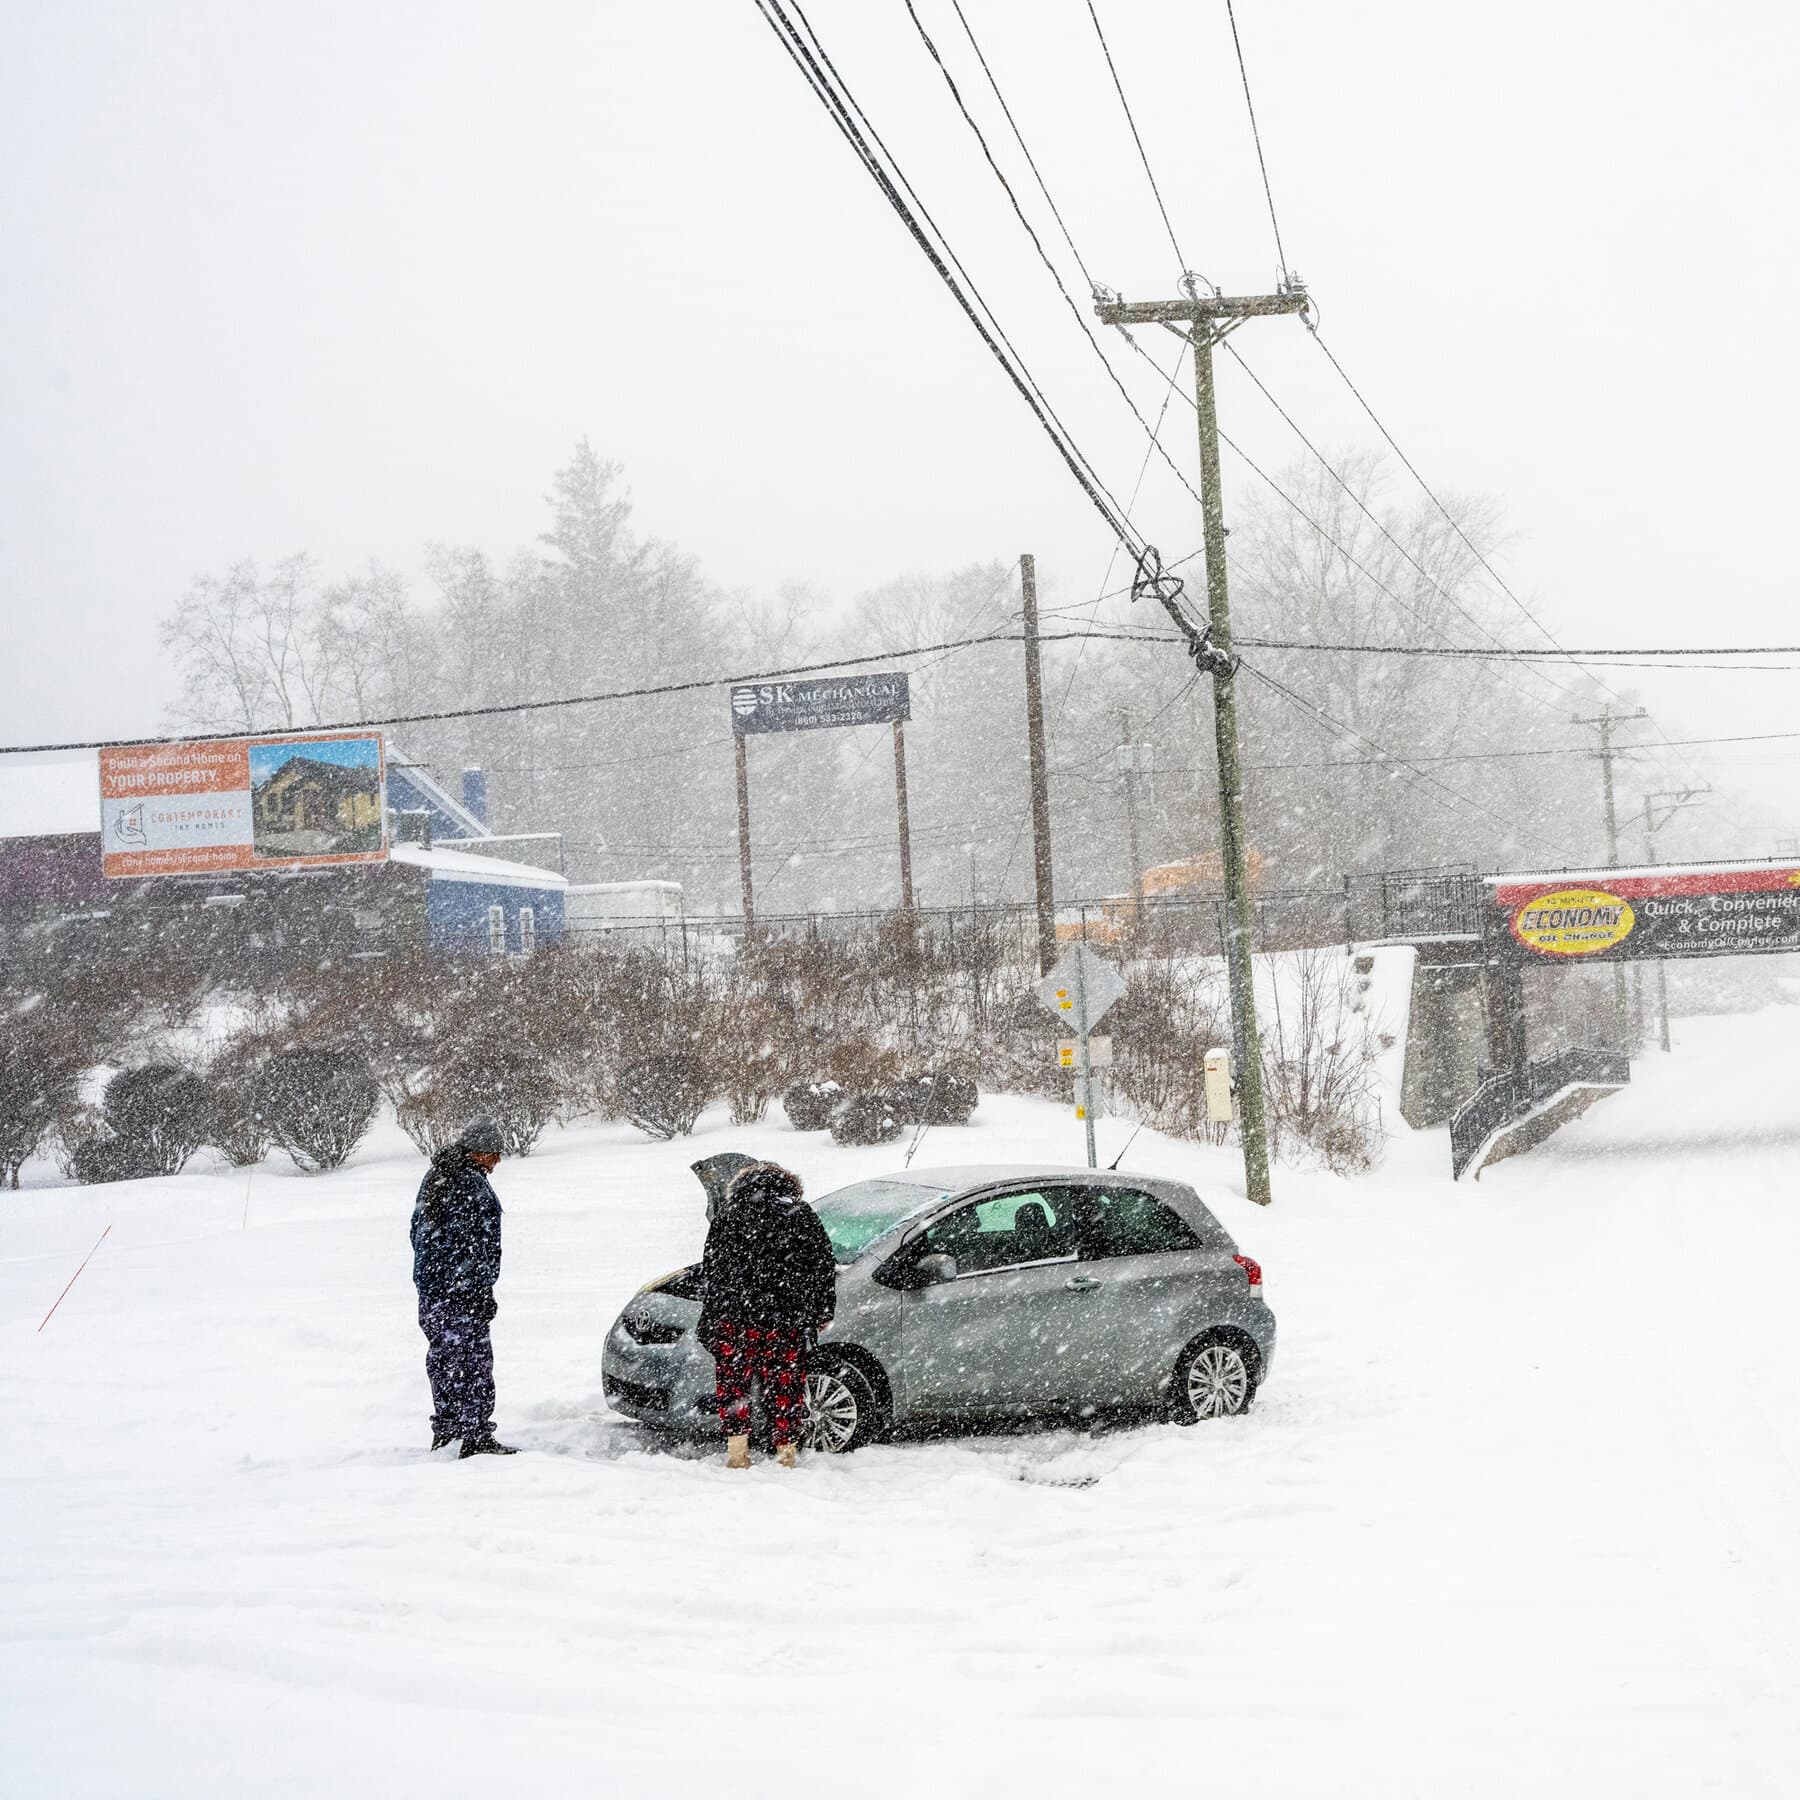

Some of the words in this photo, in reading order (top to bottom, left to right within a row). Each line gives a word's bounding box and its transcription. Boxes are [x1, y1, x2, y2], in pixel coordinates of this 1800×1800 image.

[760, 685, 794, 704] SK
[109, 756, 137, 769] Build
[149, 754, 190, 768] Second
[192, 752, 225, 766] Home
[228, 753, 241, 762] on
[109, 774, 145, 788] YOUR
[148, 769, 217, 786] PROPERTY
[1522, 905, 1625, 931] ECONOMY
[1679, 919, 1693, 933] &
[1697, 914, 1782, 934] Complete
